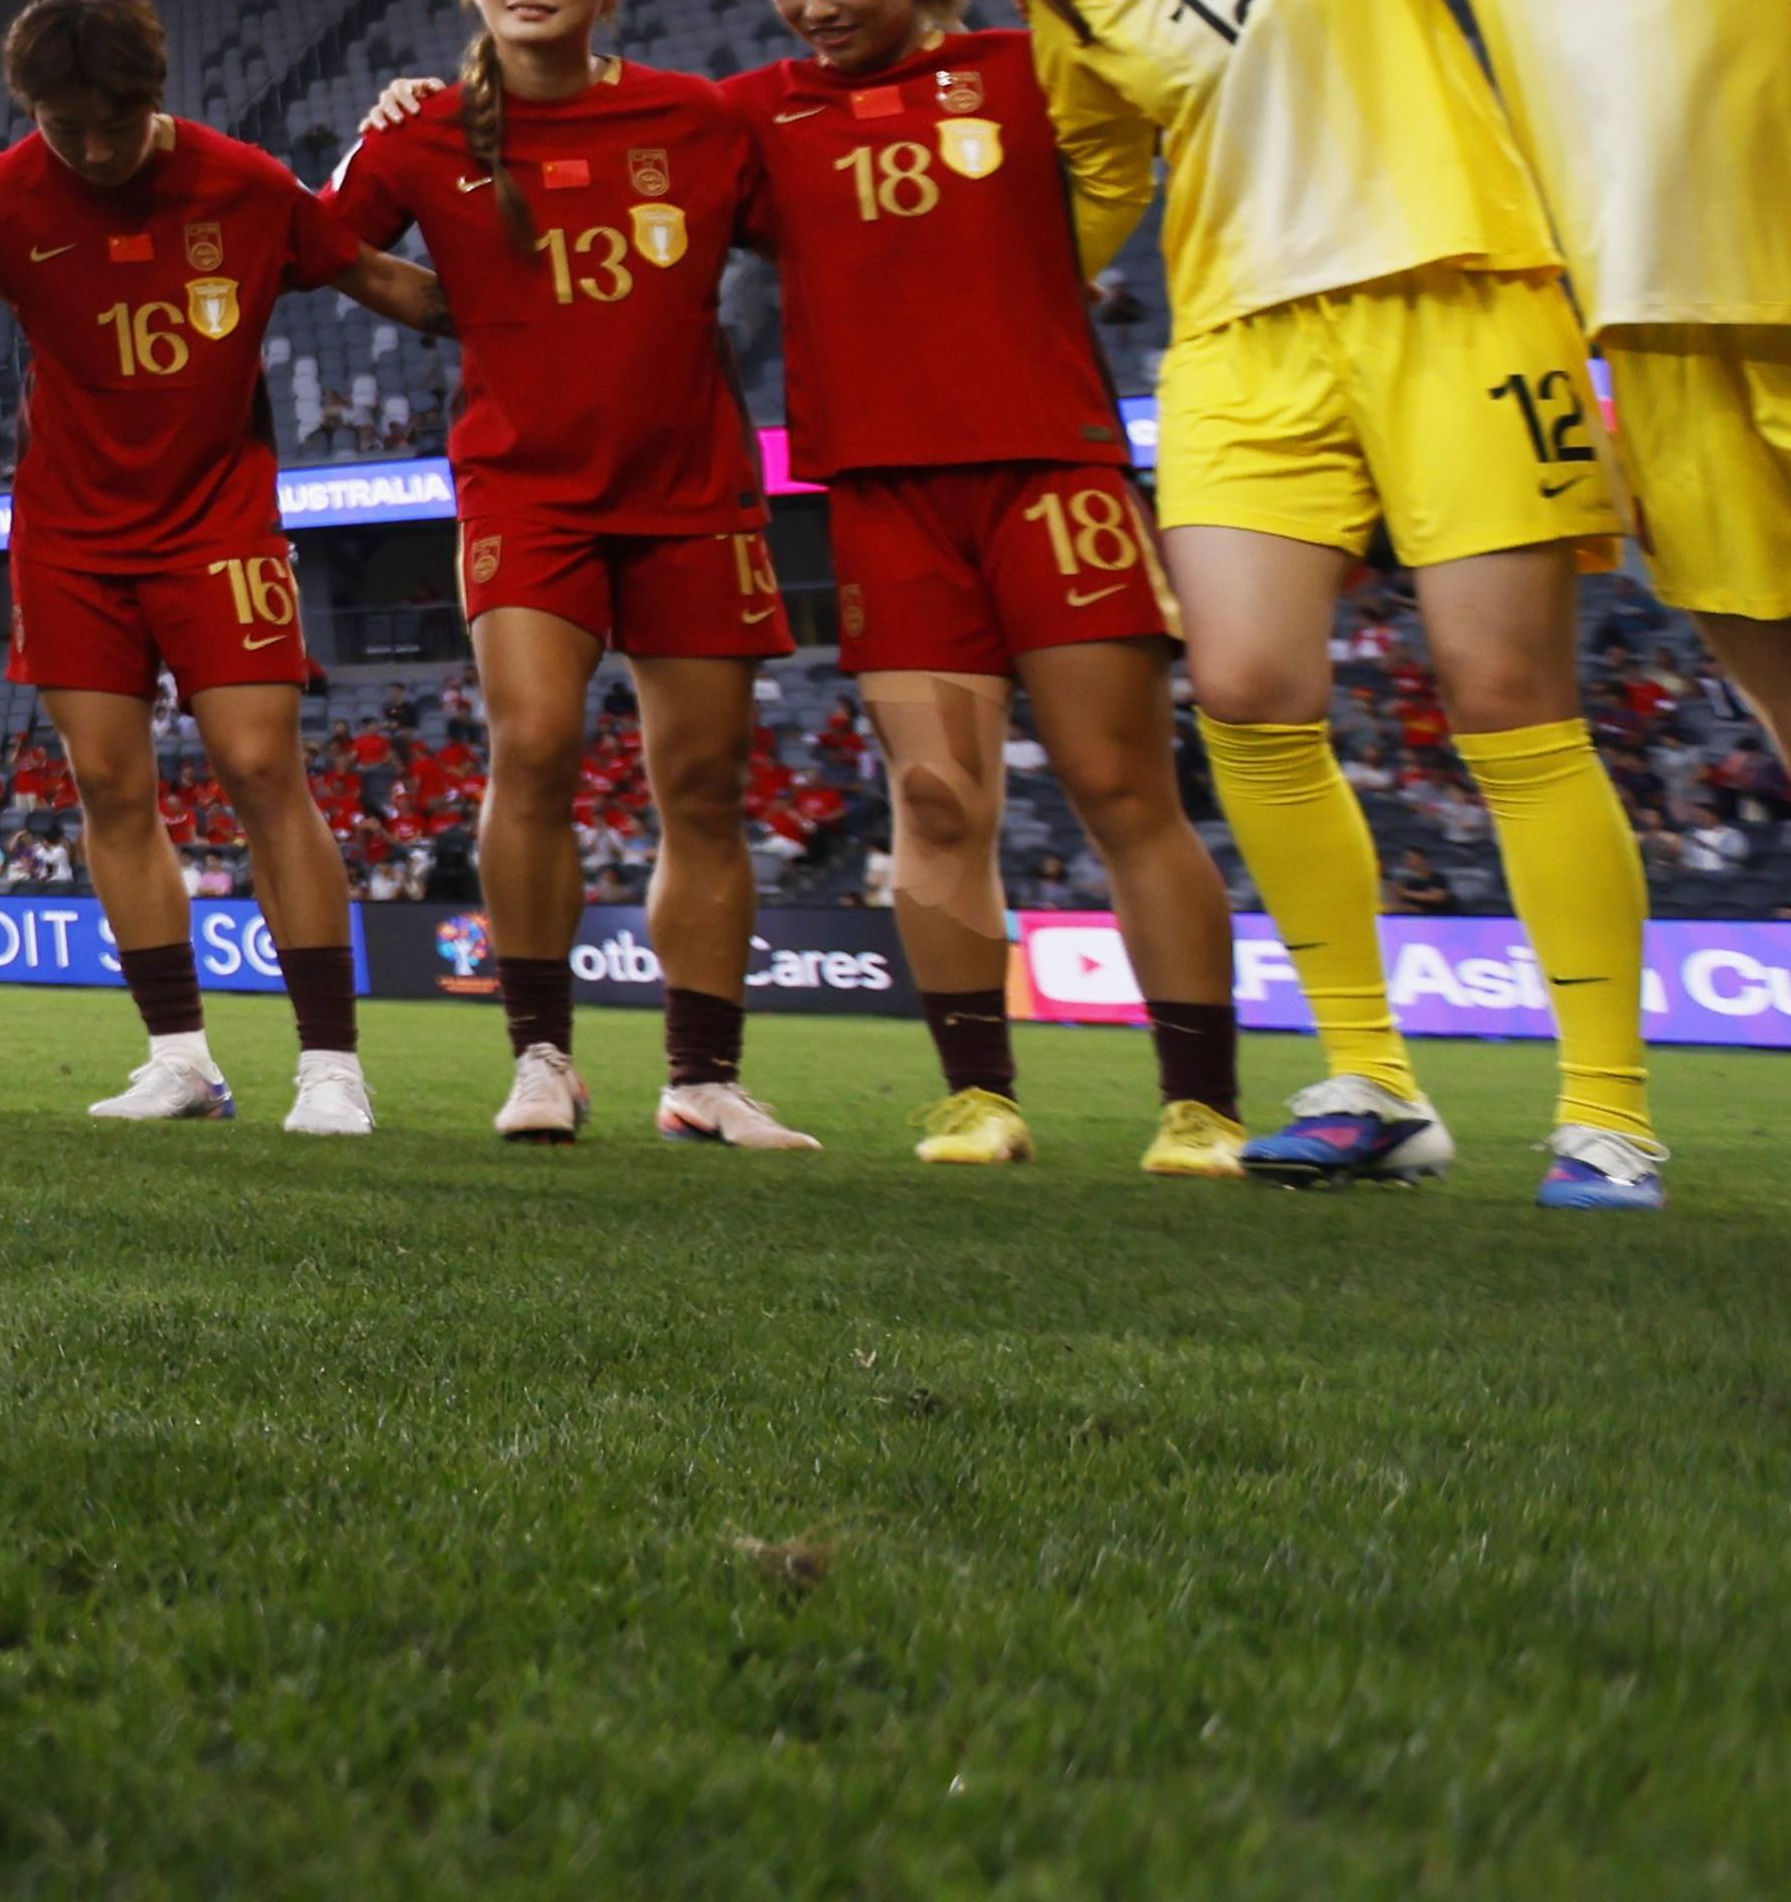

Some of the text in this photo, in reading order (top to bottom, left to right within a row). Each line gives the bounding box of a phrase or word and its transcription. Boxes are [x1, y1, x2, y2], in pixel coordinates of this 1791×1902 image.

[833, 141, 939, 222] 18
[535, 226, 633, 304] 13
[97, 301, 190, 376] 16
[1487, 368, 1600, 463] 12
[1024, 489, 1137, 576] 18
[208, 557, 294, 626] 16
